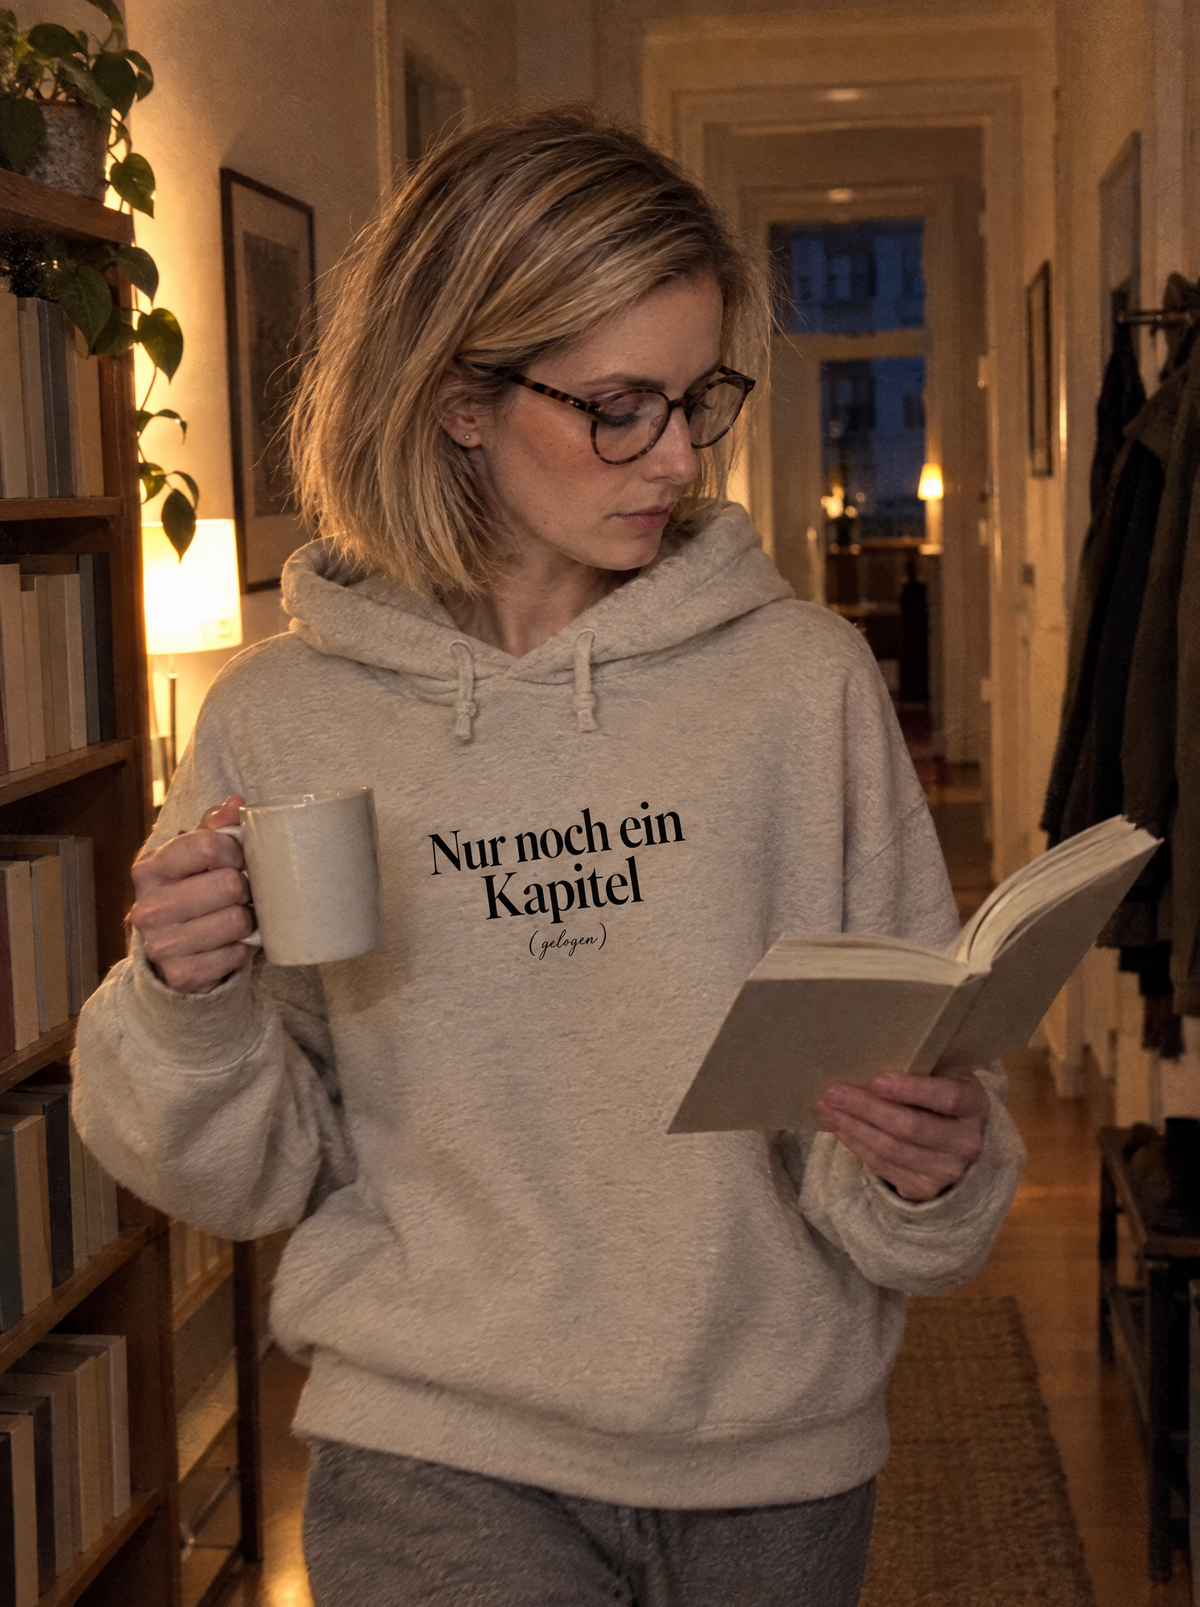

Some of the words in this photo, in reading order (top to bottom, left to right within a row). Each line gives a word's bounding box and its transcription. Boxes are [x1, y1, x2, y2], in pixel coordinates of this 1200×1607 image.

[428, 830, 506, 875] Nur
[514, 808, 612, 862] noch
[620, 801, 685, 848] ein
[481, 855, 644, 924] Kapitel
[529, 922, 607, 960] (gelogen)
